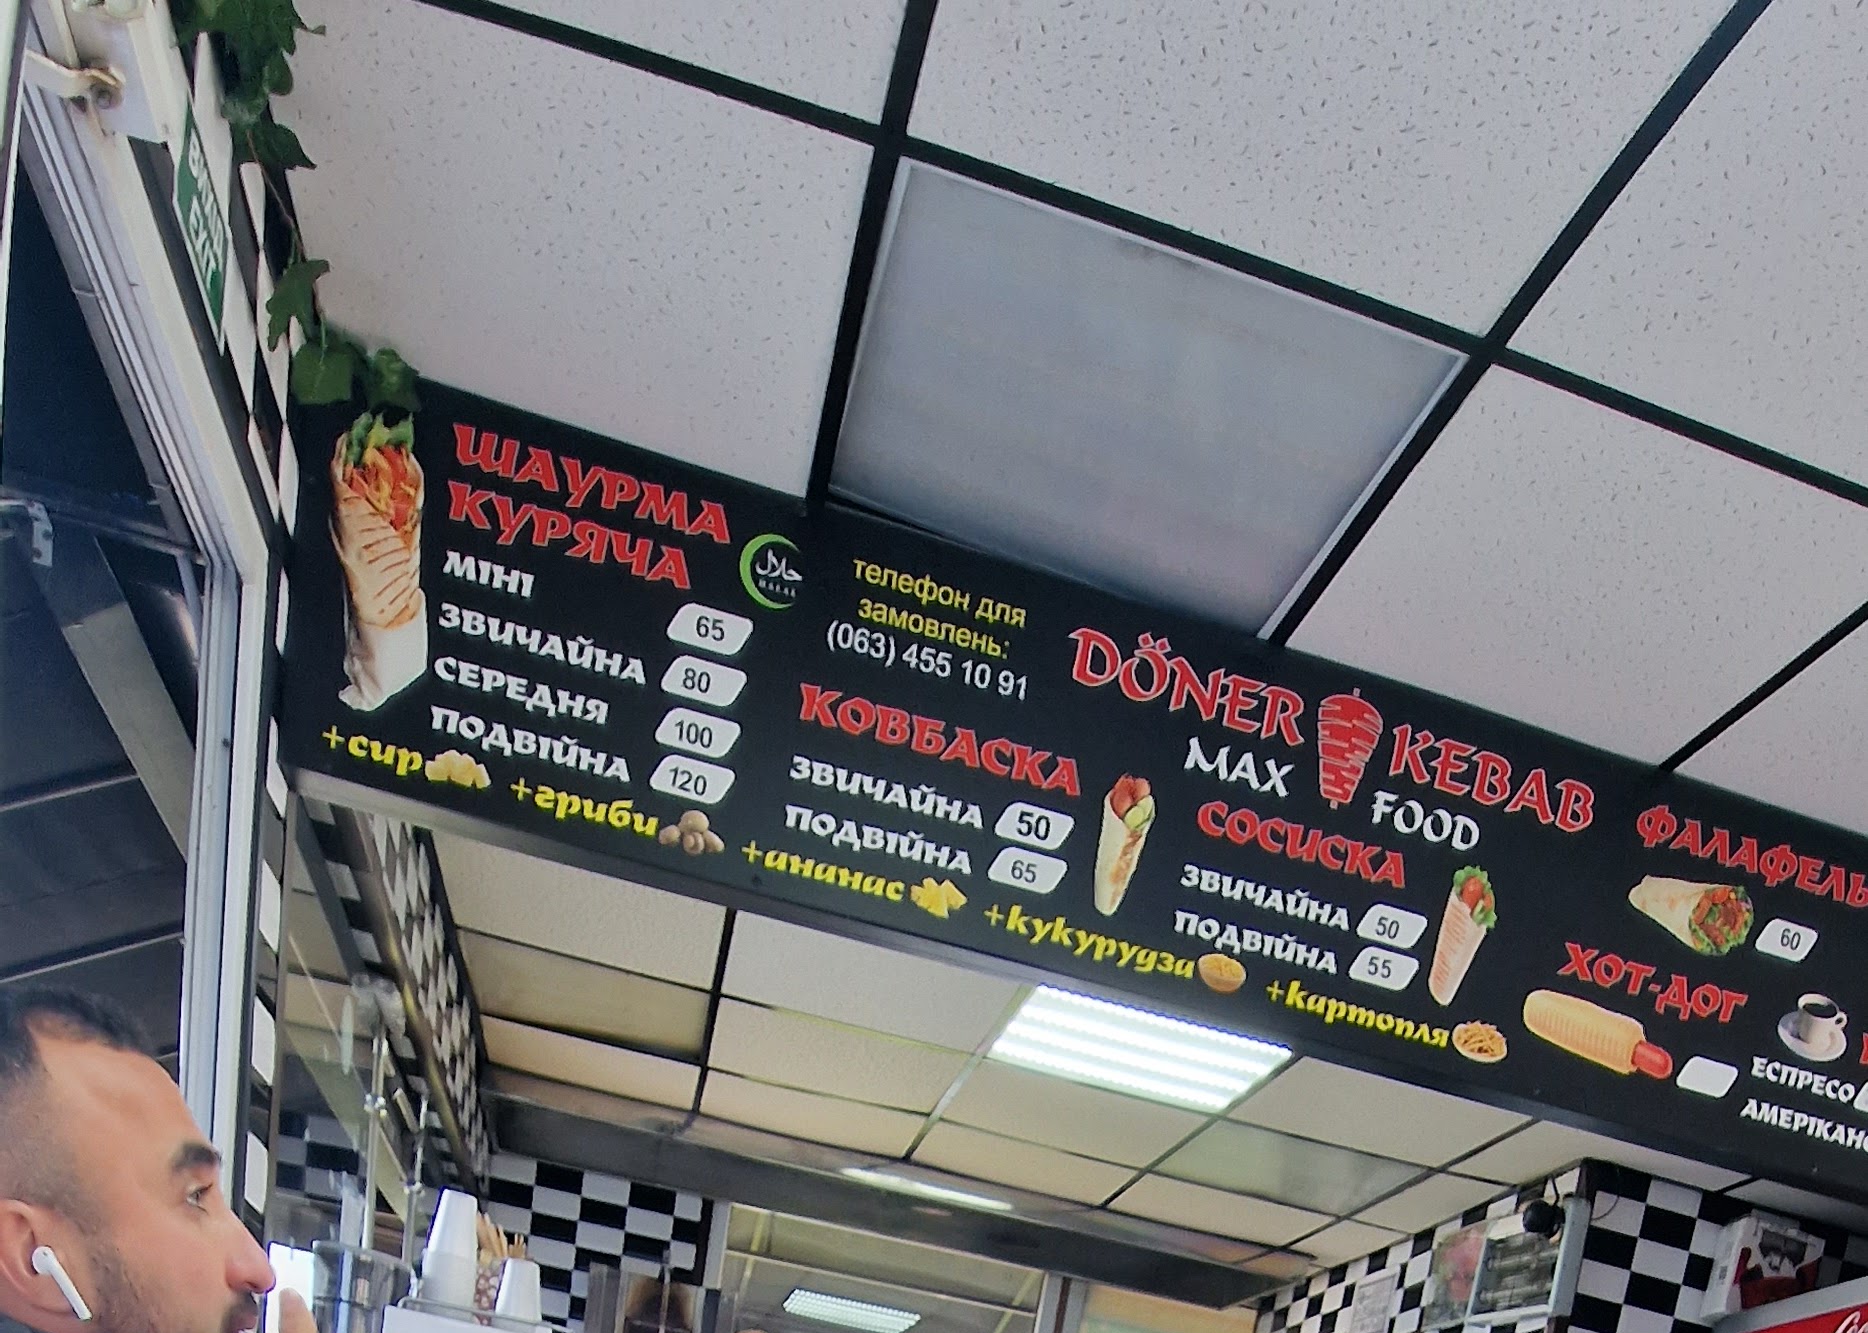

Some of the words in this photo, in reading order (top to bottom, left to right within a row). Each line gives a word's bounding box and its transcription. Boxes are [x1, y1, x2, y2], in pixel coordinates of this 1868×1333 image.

[188, 196, 218, 291] EXIT
[453, 422, 731, 543] ШАУРМА
[447, 480, 691, 589] КУРЯЧА
[755, 548, 802, 581] حلال
[442, 550, 535, 599] МІНІ
[696, 614, 726, 642] 65
[853, 558, 970, 611] телефон
[975, 597, 1026, 628] для
[858, 598, 1010, 660] замовлень:
[438, 602, 647, 686] ЗВИЧАЙНА
[682, 667, 712, 695] 80
[827, 619, 896, 668] (063)
[902, 643, 952, 678] 455
[961, 659, 992, 689] 10
[998, 670, 1028, 701] 91
[434, 656, 609, 725] СЕРЕДНЯ
[675, 720, 713, 749] 100
[800, 682, 1081, 796] КОВБАСКА
[1068, 627, 1305, 747] DÖNER
[1389, 723, 1595, 833] KEBAB
[322, 725, 423, 776] +сир
[430, 705, 631, 783] ПОДВІЙНА
[668, 766, 707, 796] 120
[510, 778, 659, 838] +гриби
[789, 754, 984, 829] ЗВИЧАЙНА
[1016, 811, 1050, 841] 50
[1183, 736, 1295, 797] MAX
[1371, 790, 1480, 851] FOOD
[741, 840, 906, 902] +ананас
[784, 803, 973, 875] ПОДВІЙНА
[1010, 859, 1037, 883] 65
[1197, 801, 1406, 889] СОСИСКА
[1636, 805, 1868, 908] ФАЛАФЕЛЬ
[984, 904, 1195, 979] +кукурудза
[1180, 863, 1350, 932] ЗВИЧАЙНА
[1375, 916, 1400, 940] 50
[1780, 927, 1802, 951] 60
[1174, 909, 1338, 975] ПОДВІЙНА
[1368, 956, 1392, 979] 55
[1557, 941, 1748, 1024] ХОТ-ДОГ
[1265, 979, 1450, 1048] +картопля
[1751, 1056, 1856, 1104] ЕСПРЕСО
